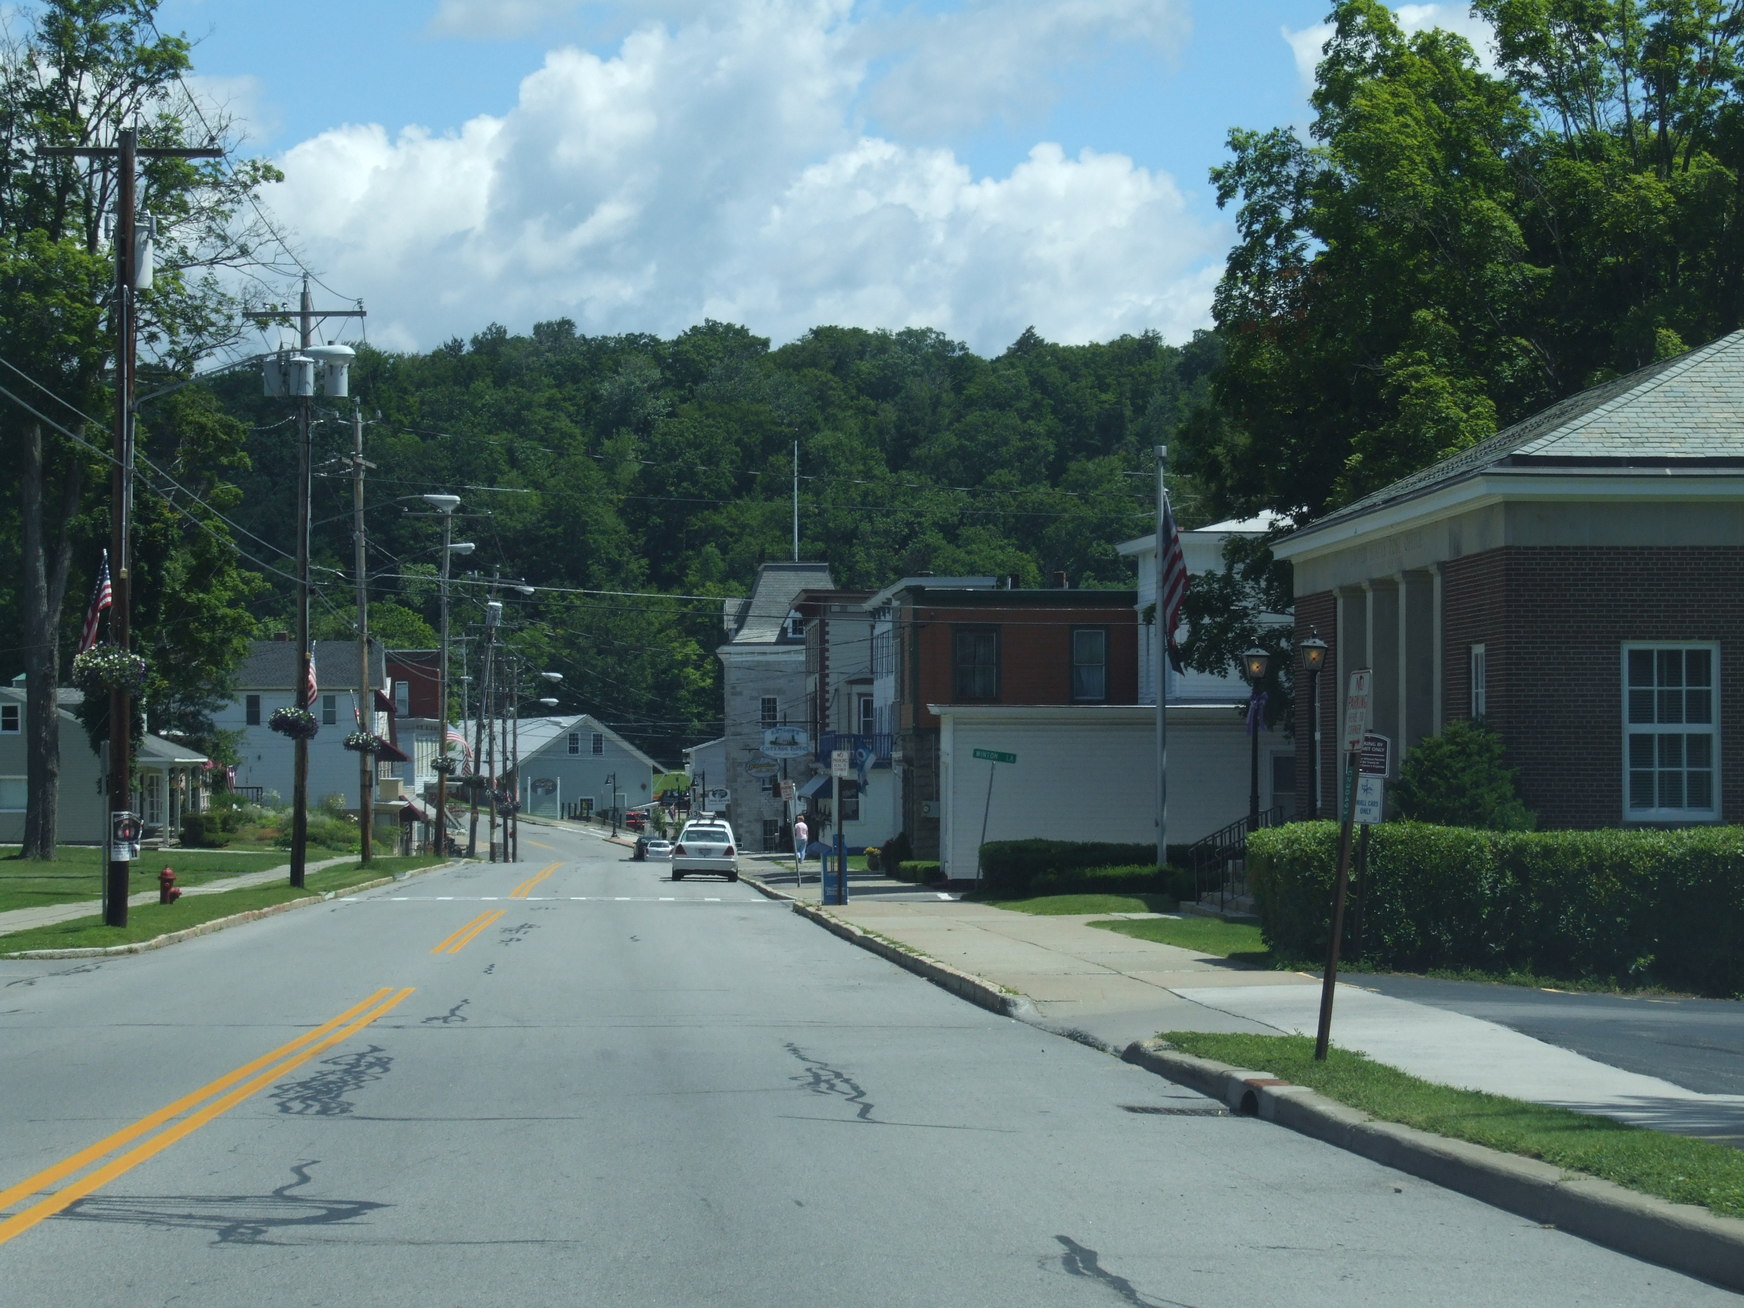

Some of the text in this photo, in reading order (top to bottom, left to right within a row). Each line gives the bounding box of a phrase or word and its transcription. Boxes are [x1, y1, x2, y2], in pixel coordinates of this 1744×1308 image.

[1356, 676, 1365, 691] NO
[1348, 694, 1368, 709] PARKING
[1367, 800, 1379, 808] CARS
[1360, 807, 1372, 815] ONLY
